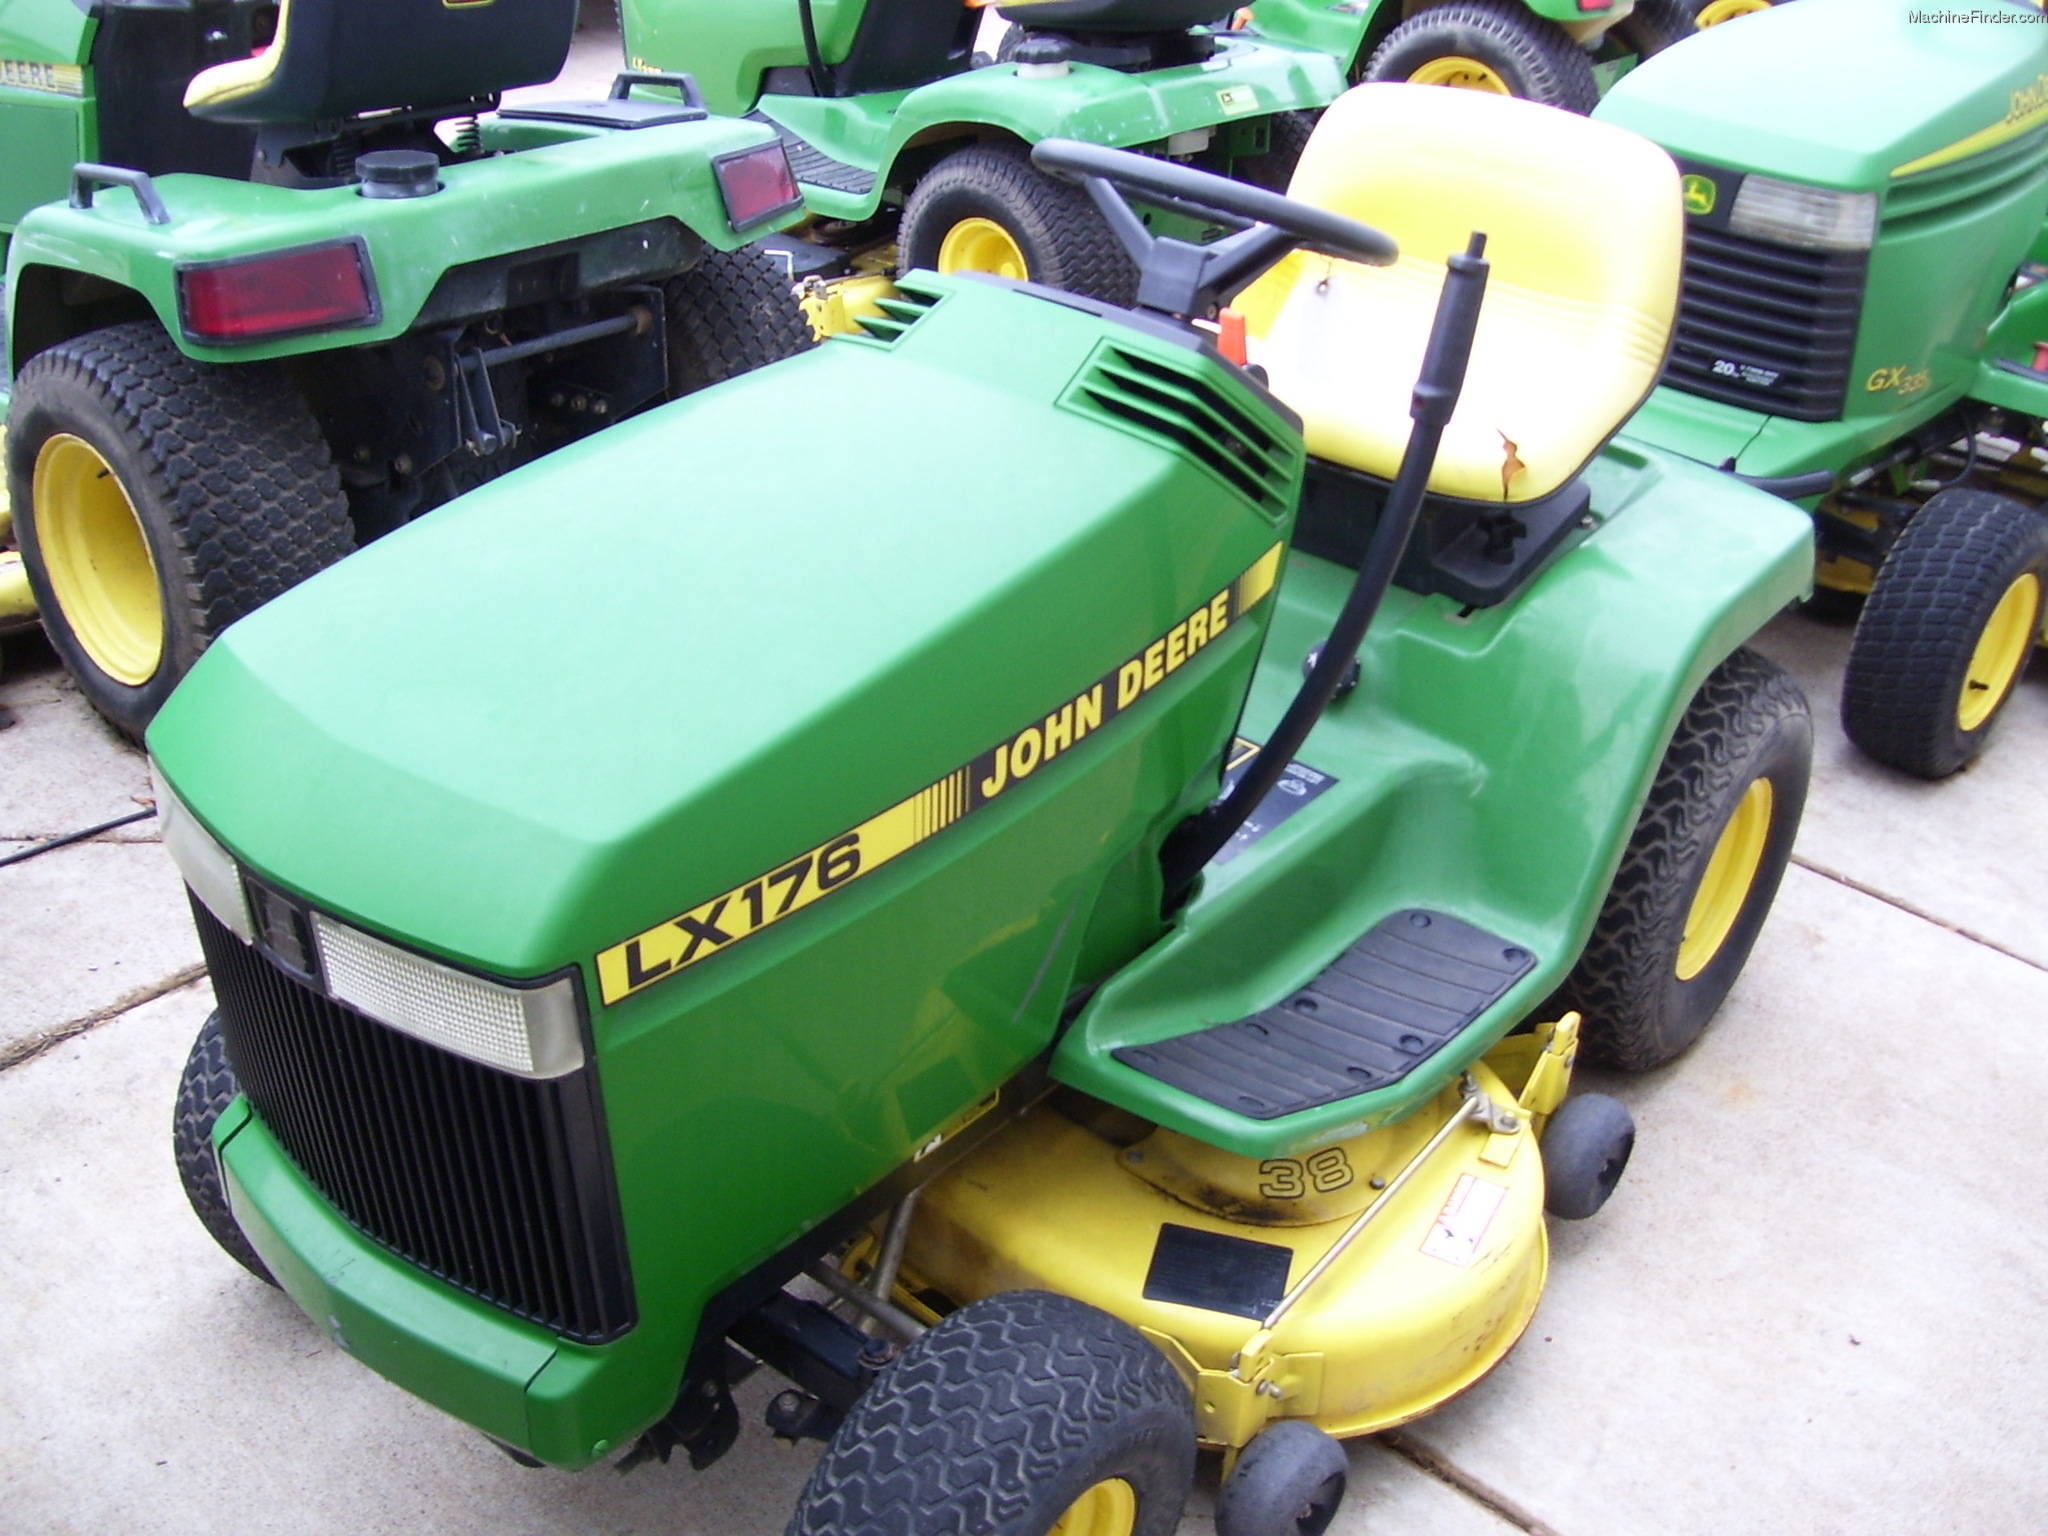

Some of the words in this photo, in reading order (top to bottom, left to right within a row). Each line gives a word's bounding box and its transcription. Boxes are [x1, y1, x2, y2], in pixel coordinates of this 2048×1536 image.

[981, 683, 1103, 799] JOHN
[1117, 588, 1230, 711] DEERE
[624, 832, 862, 990] LX176
[1259, 1146, 1354, 1199] 38
